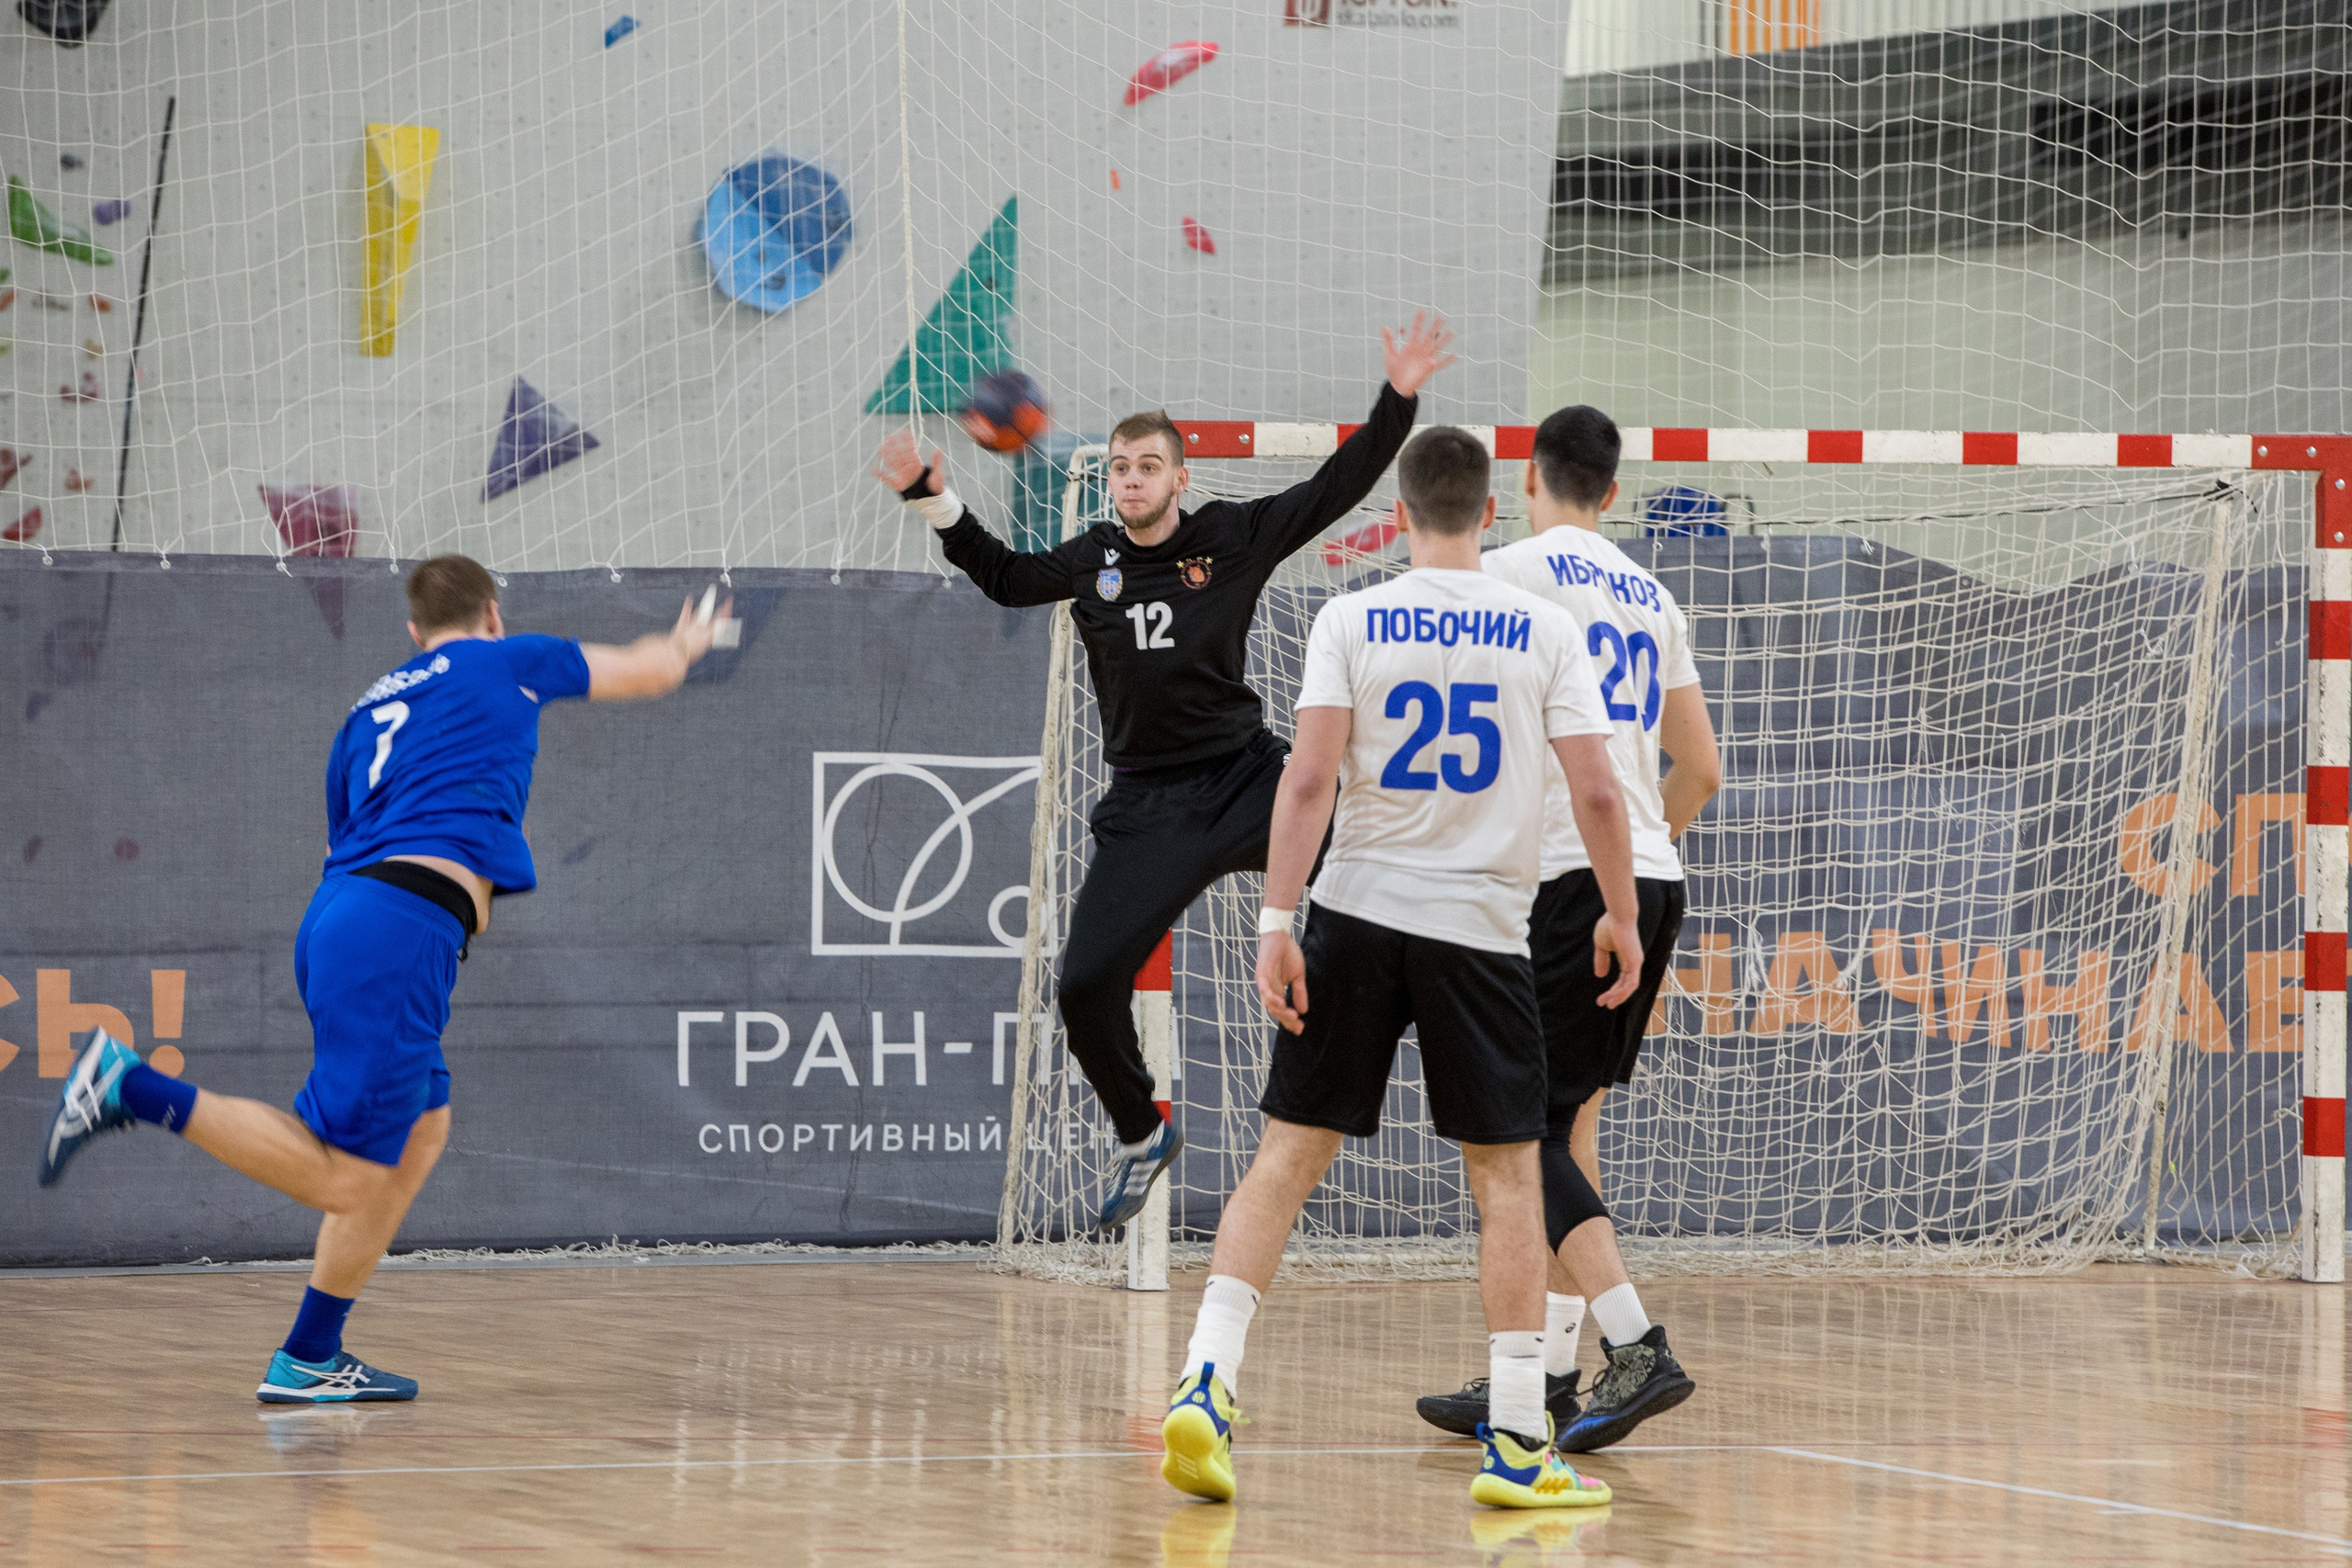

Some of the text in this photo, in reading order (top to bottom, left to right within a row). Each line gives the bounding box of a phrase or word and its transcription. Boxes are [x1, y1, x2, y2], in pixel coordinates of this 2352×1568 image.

[1125, 601, 1175, 650] 12
[1366, 607, 1532, 652] ПОБОЧИЙ
[1587, 621, 1661, 732] 20
[368, 700, 411, 790] 7
[1380, 681, 1502, 794] 25
[2119, 792, 2352, 896] СП
[0, 969, 187, 1078] Ь!
[1643, 928, 2352, 1053] НАЧИНАЕ
[677, 1007, 1182, 1086] ГРАН-П
[698, 1115, 1113, 1156] СПОРТИВНЫЙ ЦЕН
